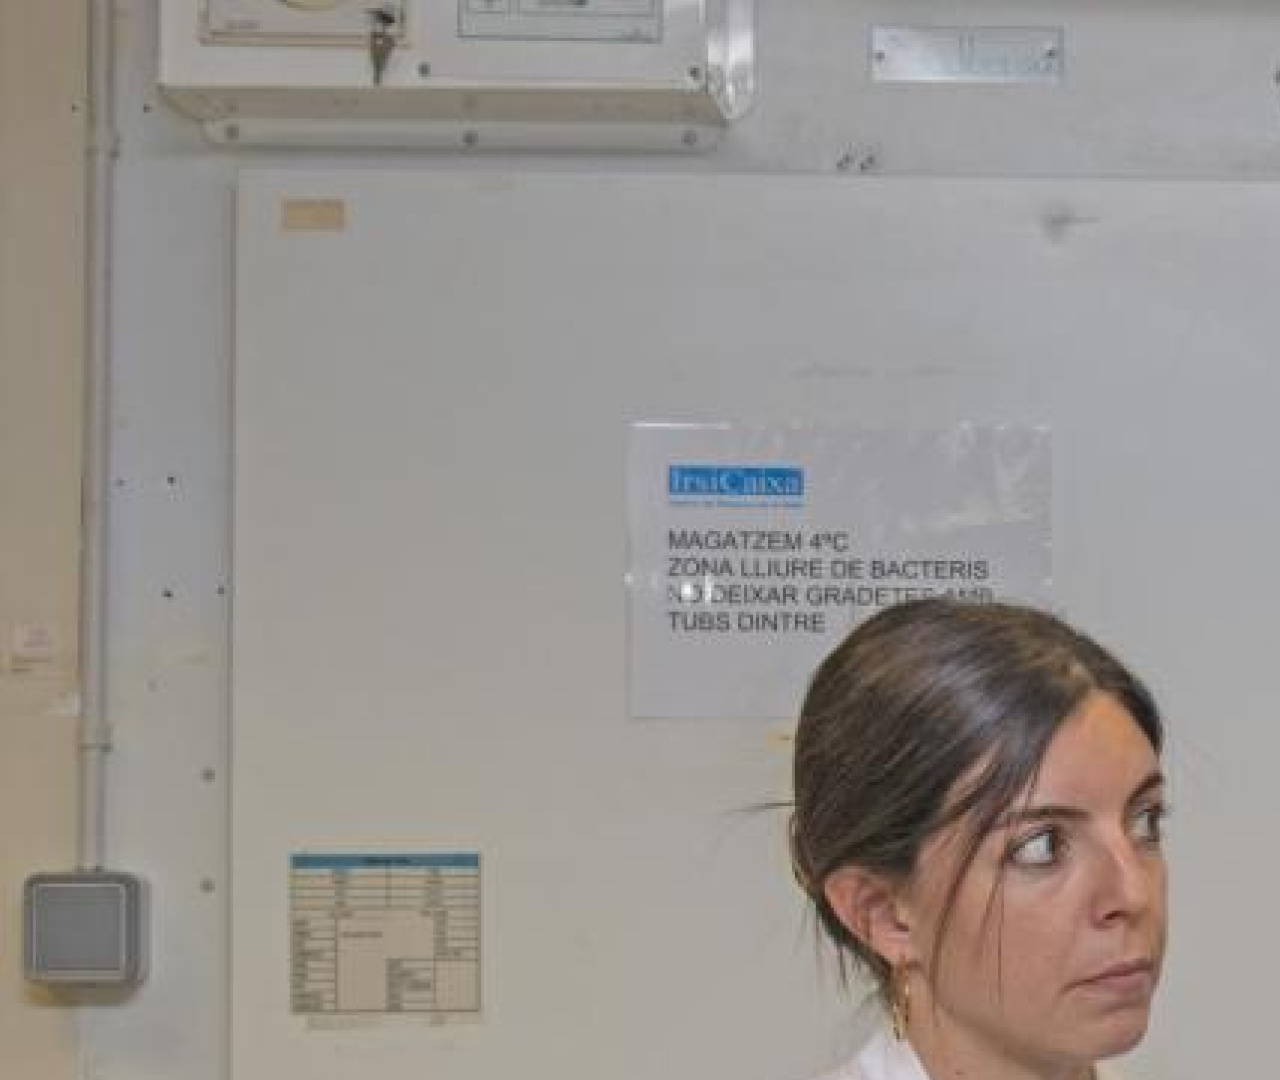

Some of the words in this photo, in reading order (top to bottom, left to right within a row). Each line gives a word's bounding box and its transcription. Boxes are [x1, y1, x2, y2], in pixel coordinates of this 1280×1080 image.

[668, 530, 802, 550] MAGATZEM
[668, 557, 733, 577] ZONA
[740, 557, 823, 579] LLIURE
[831, 559, 864, 580] DE
[871, 560, 990, 580] BACTERIS
[710, 584, 797, 605] DEIXAR
[668, 611, 730, 632] TUBS
[737, 611, 826, 633] DINTRE
